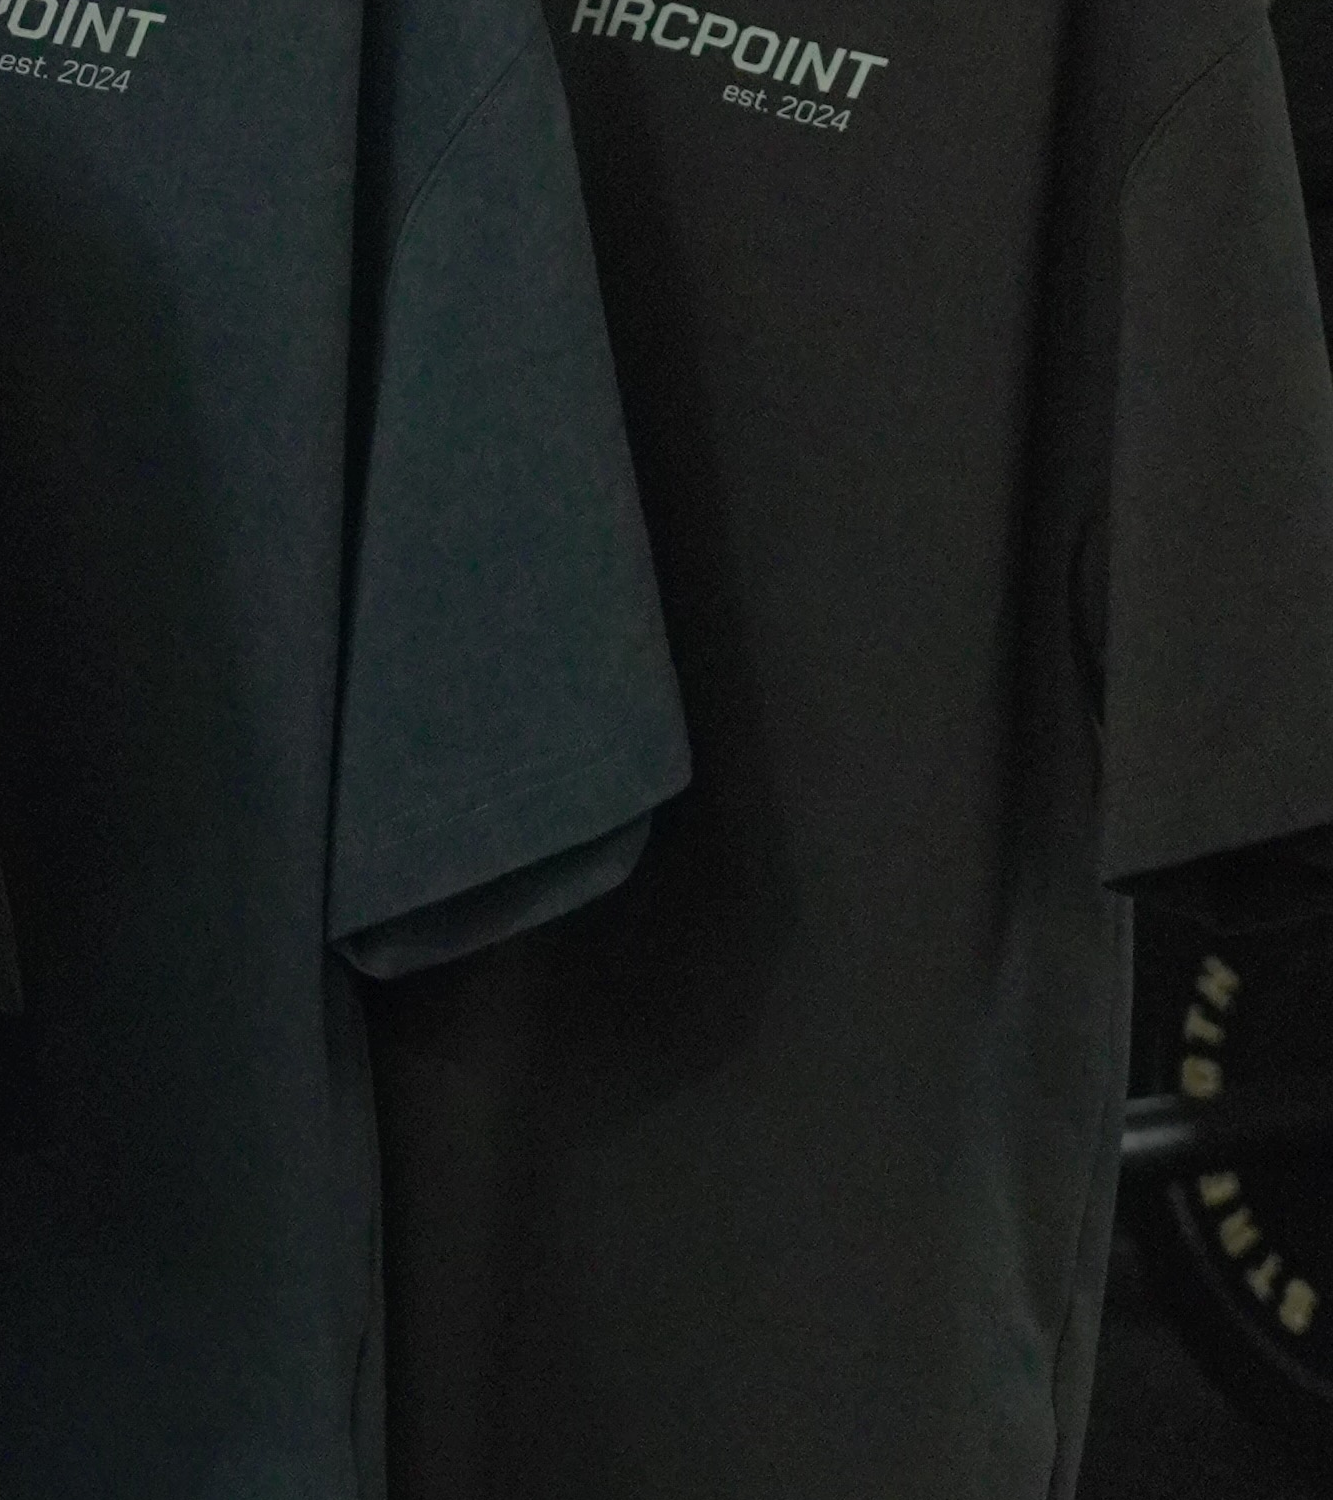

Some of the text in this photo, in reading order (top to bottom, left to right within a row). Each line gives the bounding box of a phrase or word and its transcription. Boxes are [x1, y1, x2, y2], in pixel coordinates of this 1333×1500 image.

[57, 59, 132, 93] 2024
[722, 84, 852, 132] est. 2024
[1179, 954, 1319, 1336] STREGTH
